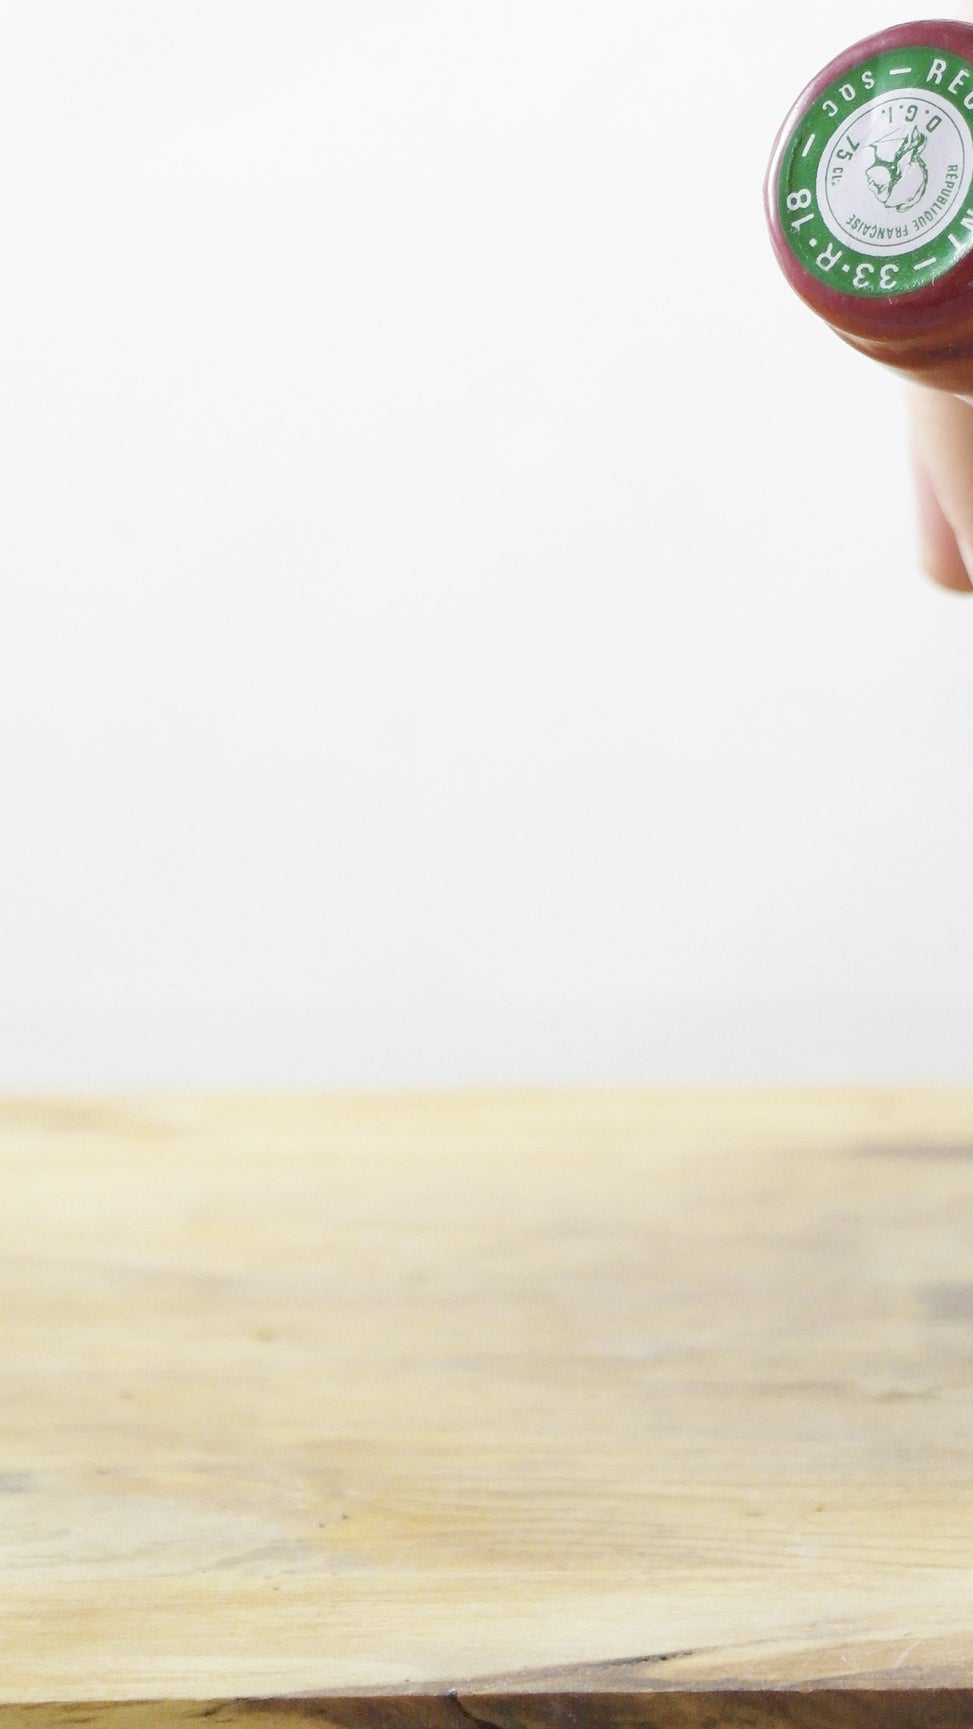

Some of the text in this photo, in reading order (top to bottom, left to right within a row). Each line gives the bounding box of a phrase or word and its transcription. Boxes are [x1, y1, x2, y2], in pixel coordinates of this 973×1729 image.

[882, 104, 942, 133] D.G.I.
[836, 135, 860, 161] 75
[846, 164, 958, 240] RÉPUBLIQUE FRANÇAISE
